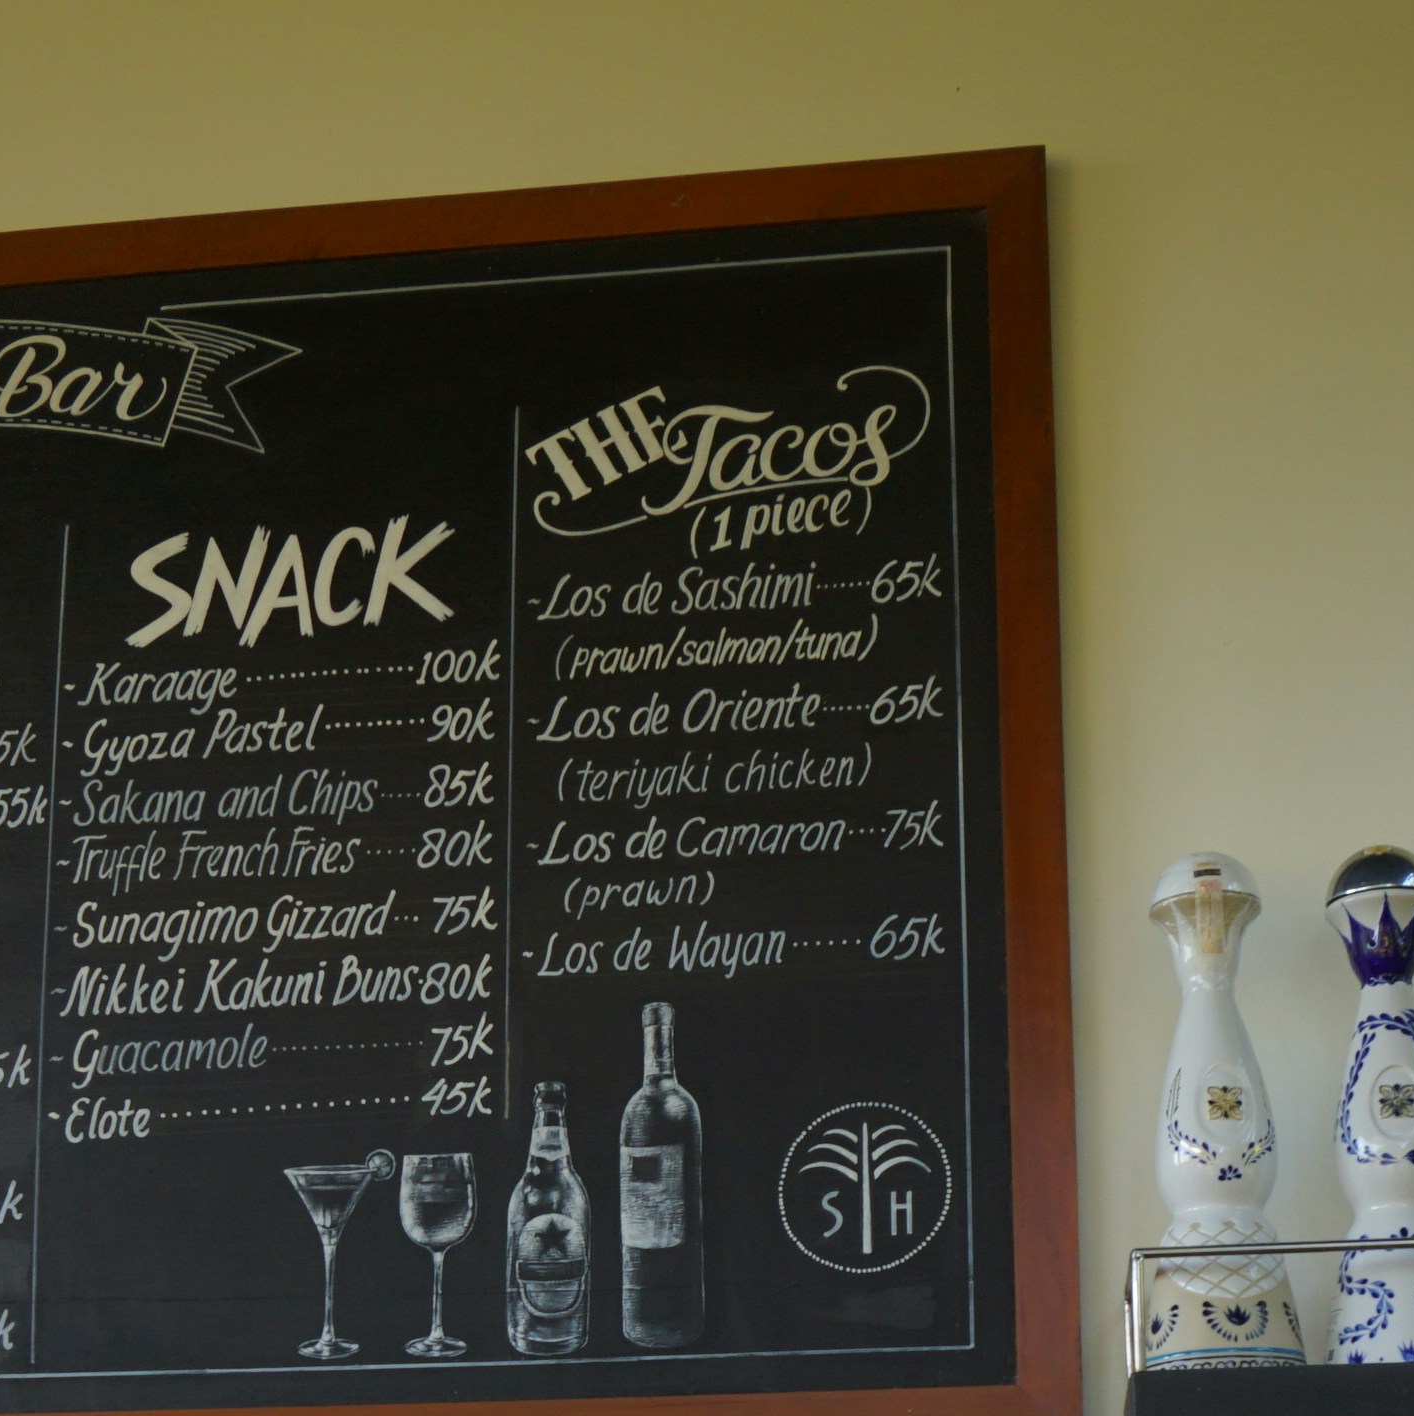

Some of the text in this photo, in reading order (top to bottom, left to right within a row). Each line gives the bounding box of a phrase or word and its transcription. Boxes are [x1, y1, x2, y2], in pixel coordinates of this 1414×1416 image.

[526, 365, 930, 515] THE Tacos
[740, 487, 871, 550] piece)
[124, 513, 456, 647] SNACK
[537, 553, 942, 621] Los de Sashimi 65k
[78, 638, 501, 715] Karaage 100k
[555, 614, 878, 681] (prawn/salmon/tuna)
[80, 697, 495, 776] Gyoza Pastel 90k
[557, 743, 872, 809] (teriyaki chicken)
[64, 1075, 492, 1142] Elote 45k
